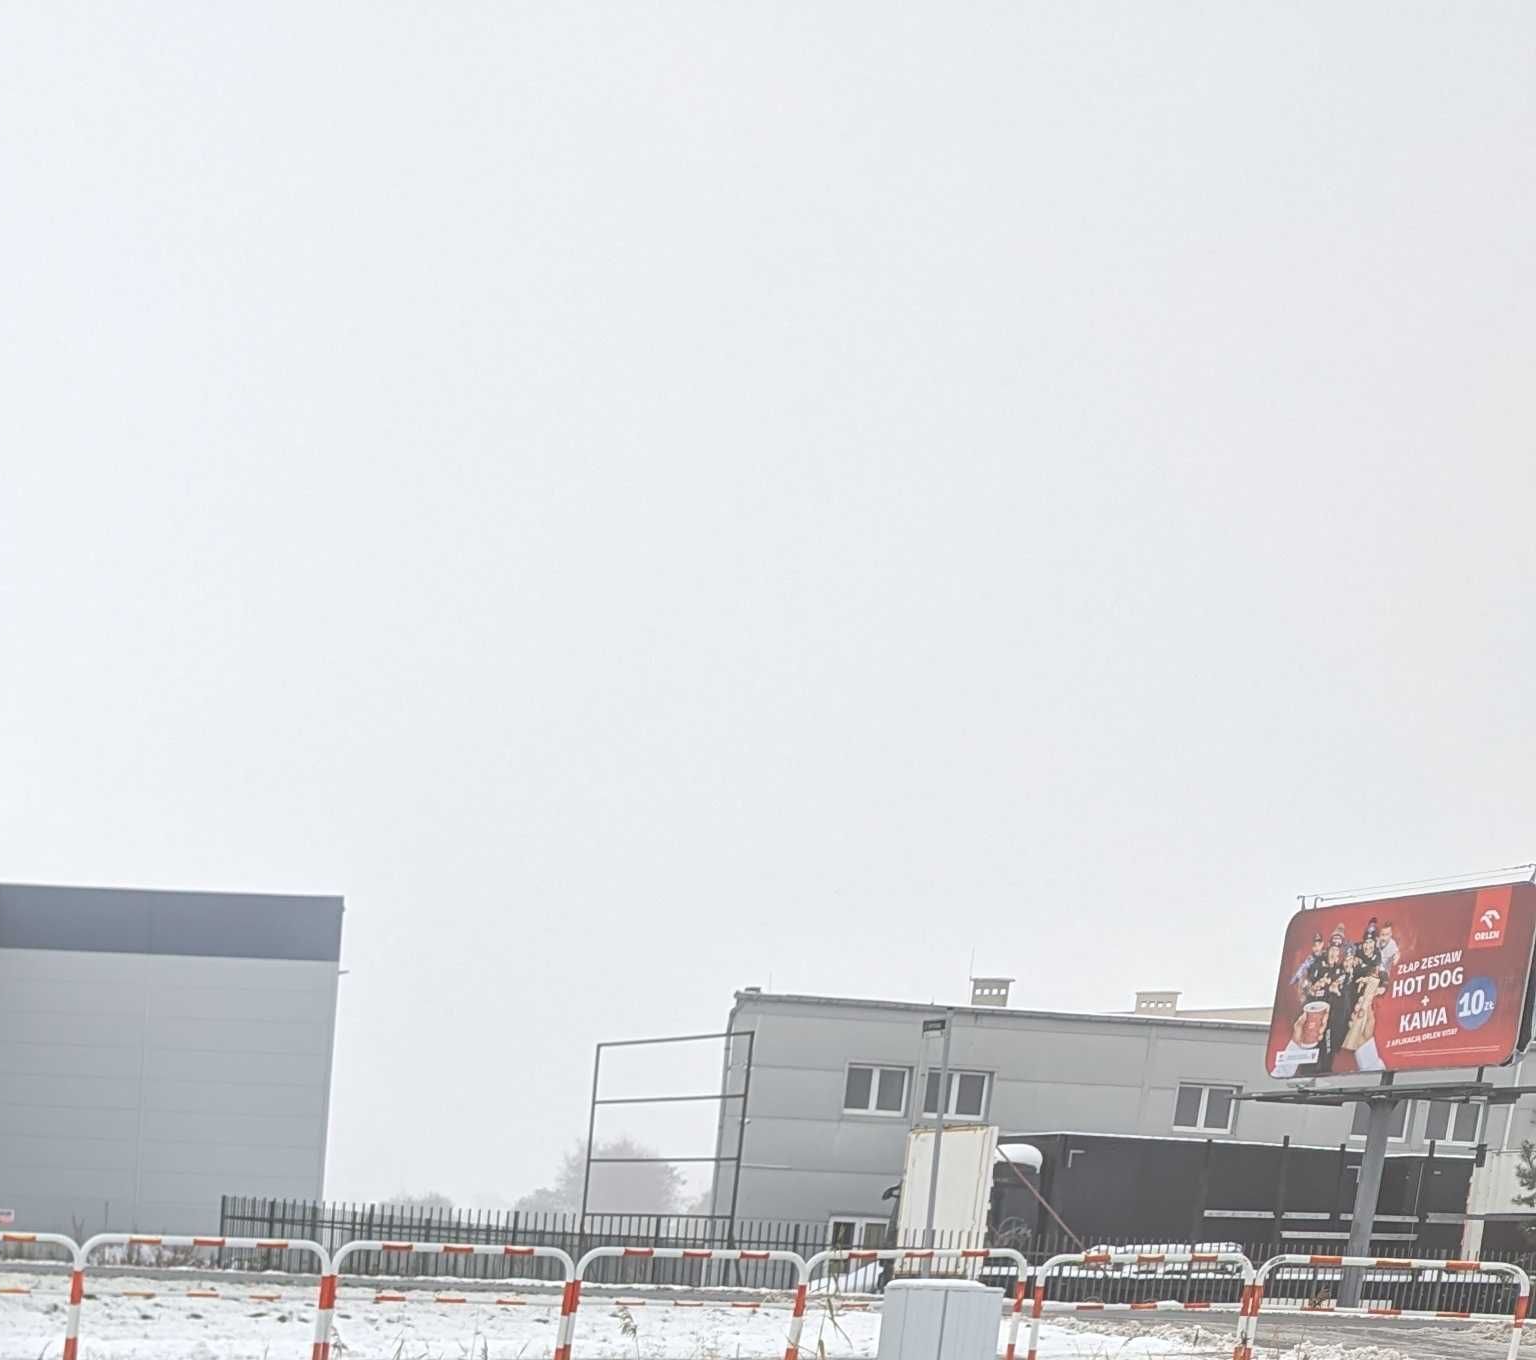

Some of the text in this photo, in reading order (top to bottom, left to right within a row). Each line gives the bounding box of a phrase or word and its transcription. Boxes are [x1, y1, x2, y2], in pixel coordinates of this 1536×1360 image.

[1474, 931, 1500, 941] ORLEN
[1397, 950, 1463, 975] ZŁAP ZESTAW
[1392, 967, 1463, 998] HOT DOG
[1458, 989, 1485, 1018] 10
[1399, 1006, 1448, 1033] KAWA
[1422, 1032, 1441, 1041] ORLEN
